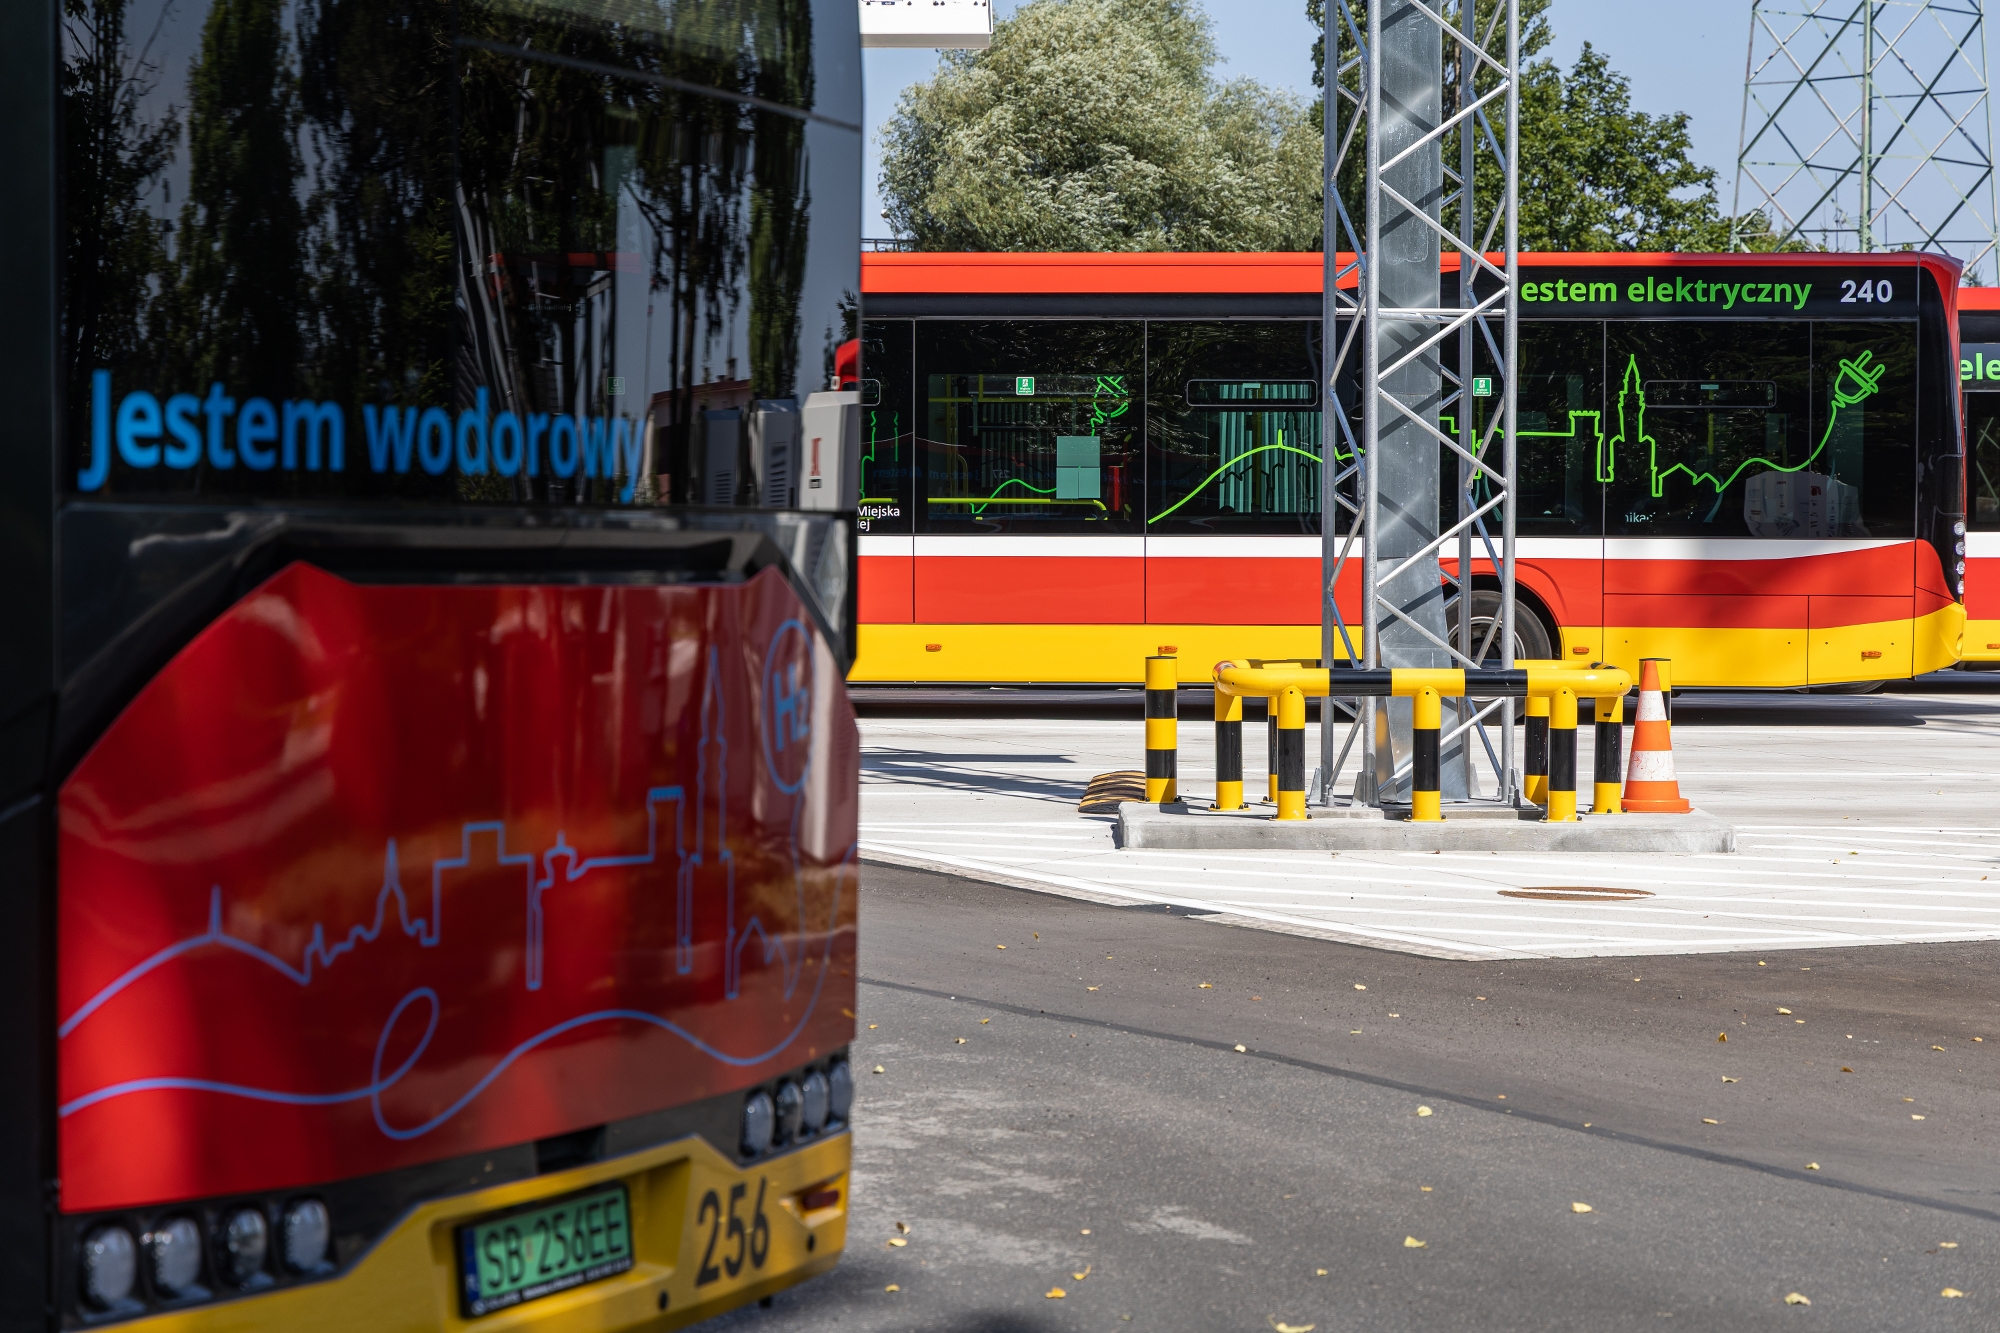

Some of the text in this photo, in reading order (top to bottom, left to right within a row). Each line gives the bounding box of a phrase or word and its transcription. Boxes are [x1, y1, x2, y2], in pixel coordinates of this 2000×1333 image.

[1521, 276, 1812, 310] estem elektryczny
[1840, 279, 1893, 303] 240
[78, 368, 644, 504] Jestem wodorowy
[857, 504, 900, 519] Miejska
[483, 1196, 624, 1289] SB 256EE
[694, 1175, 770, 1289] 256
